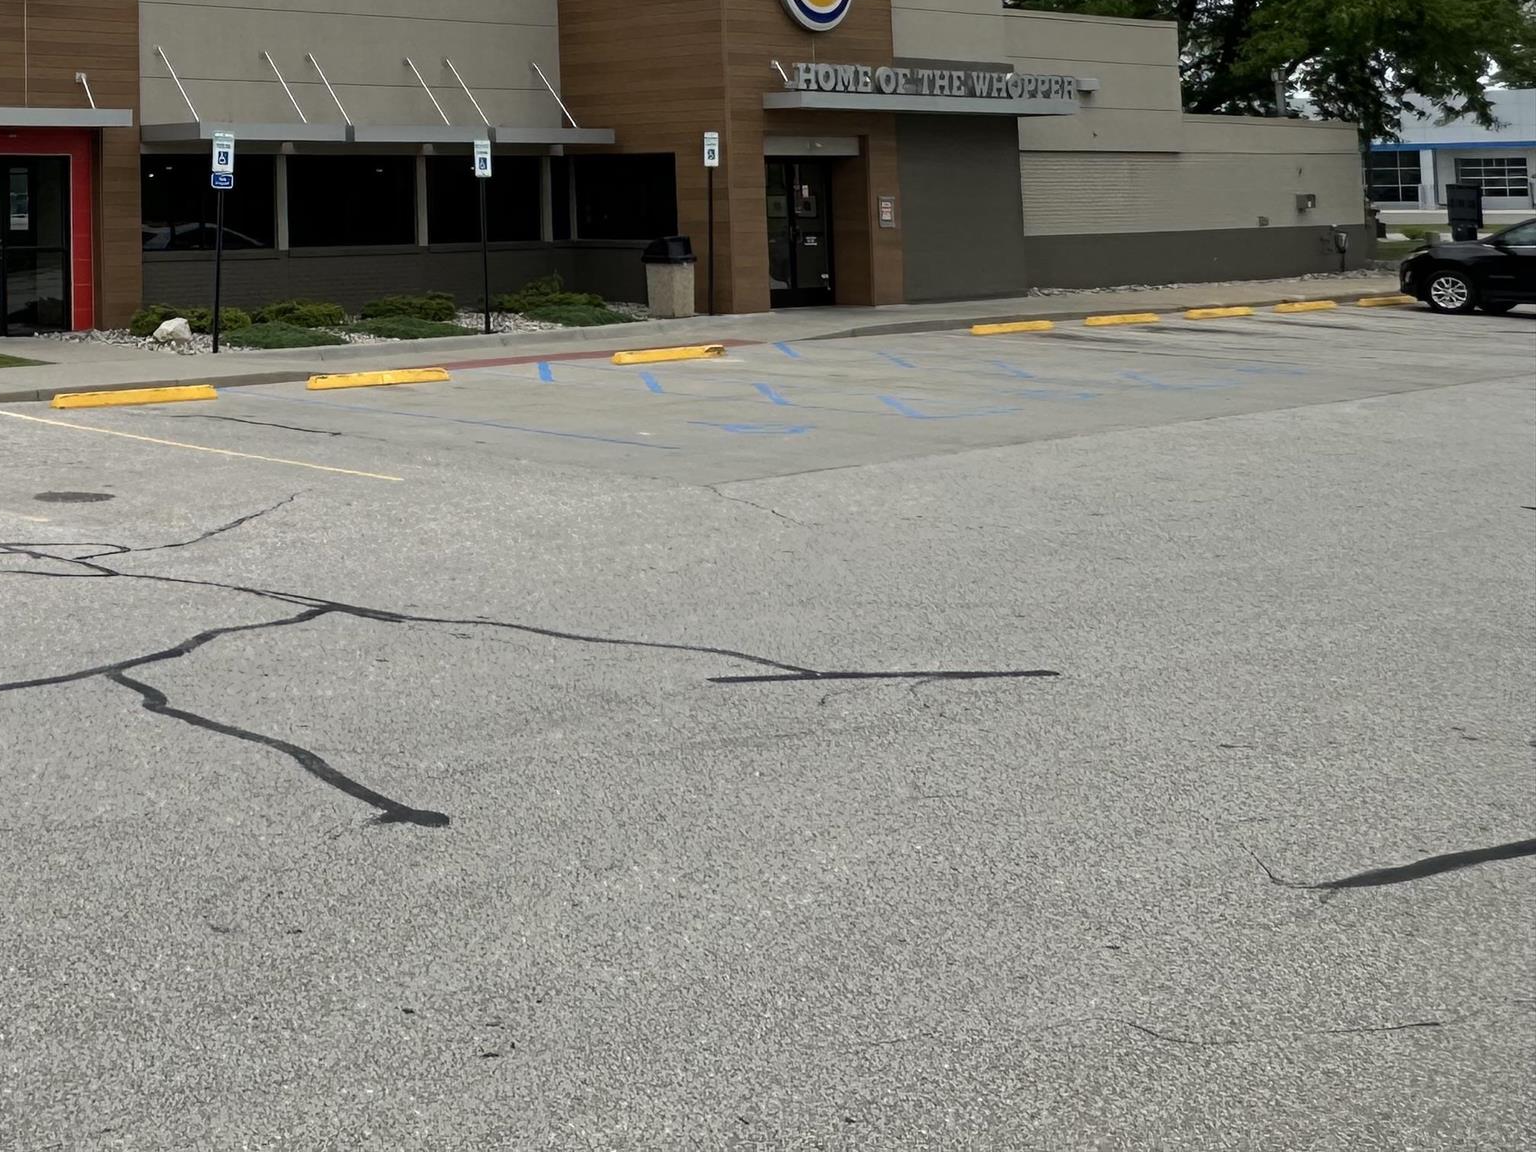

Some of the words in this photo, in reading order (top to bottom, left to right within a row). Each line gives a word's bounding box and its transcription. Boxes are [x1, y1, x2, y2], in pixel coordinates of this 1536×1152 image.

[792, 63, 872, 93] HOME
[875, 66, 910, 94] OF
[917, 69, 965, 96] THE
[971, 71, 1076, 99] WHOPPER
